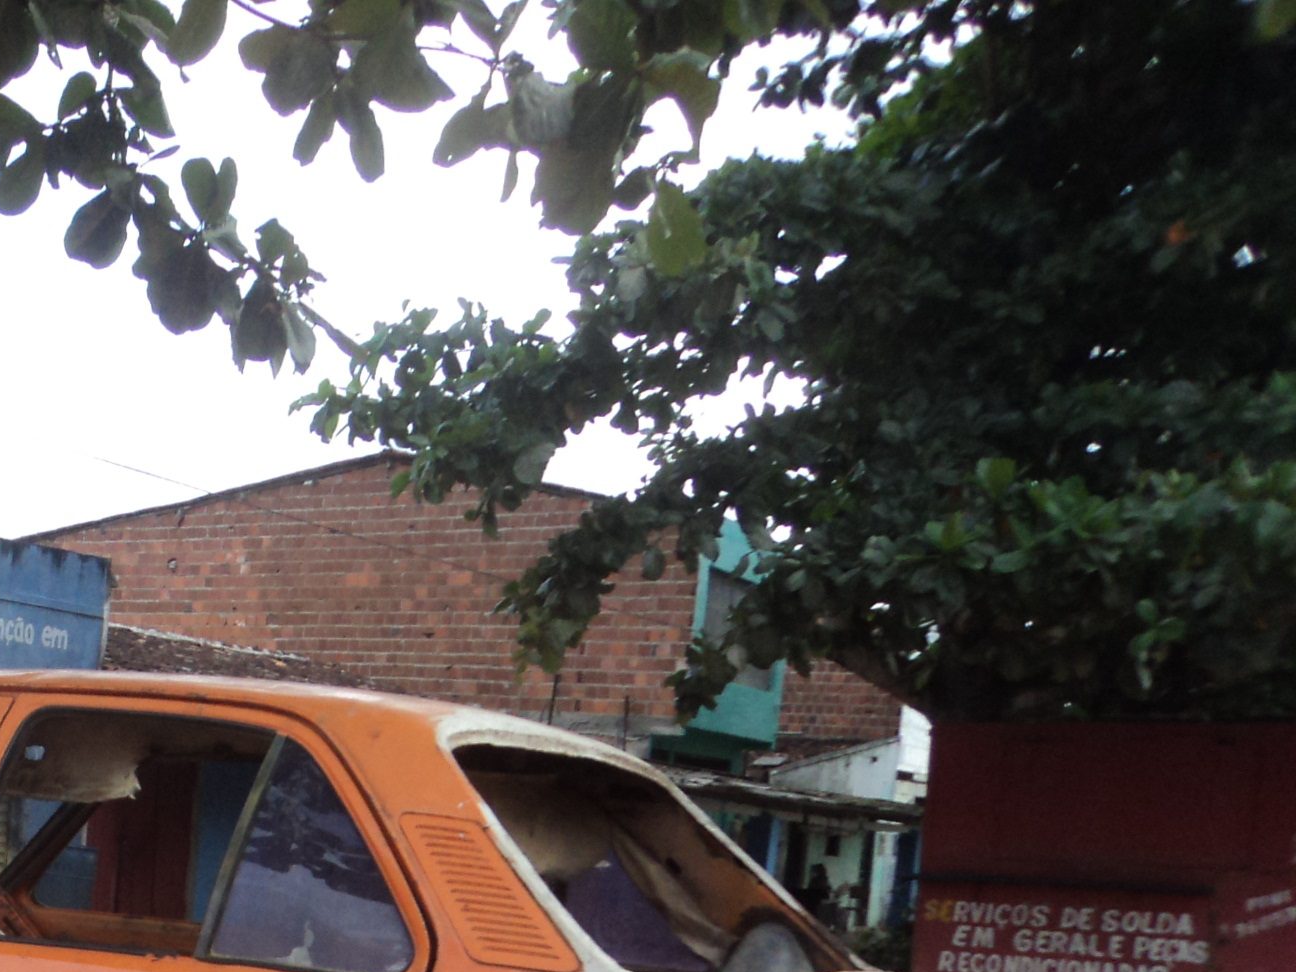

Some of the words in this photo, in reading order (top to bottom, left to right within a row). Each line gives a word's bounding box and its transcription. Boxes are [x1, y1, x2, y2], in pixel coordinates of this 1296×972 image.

[41, 624, 68, 651] em
[923, 898, 1050, 930] SERVIÇOS
[1059, 904, 1094, 931] DE
[1100, 909, 1195, 936] SOLDA
[951, 924, 994, 949] EM
[1013, 930, 1107, 958] GERAL
[1132, 936, 1210, 967] PEÇAS
